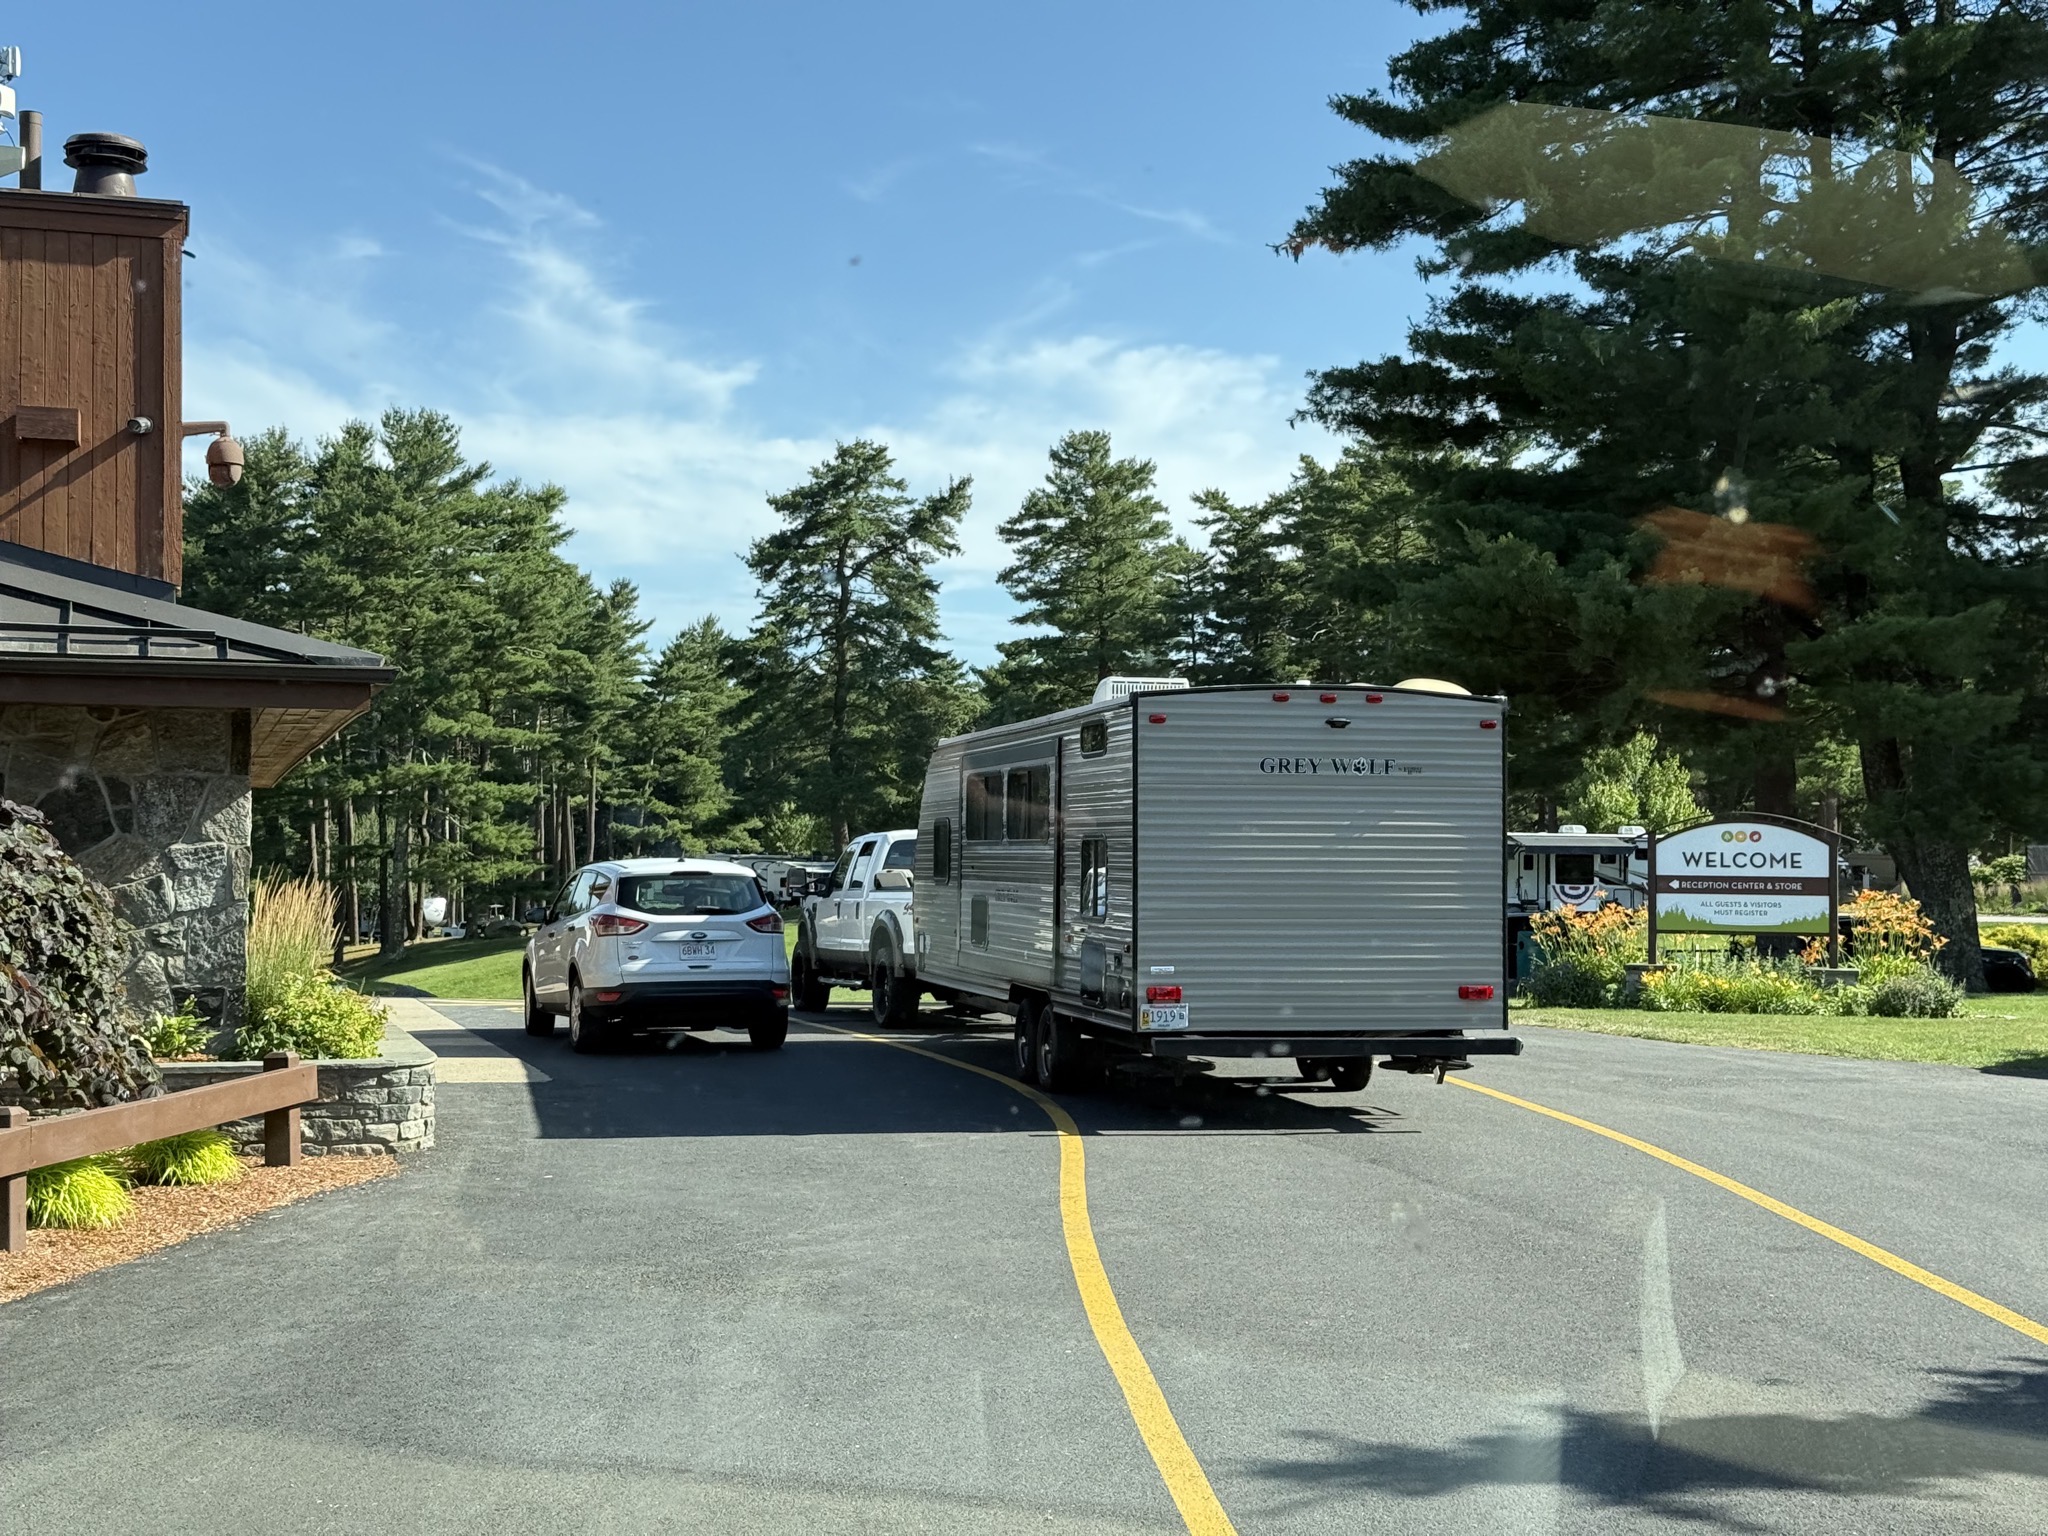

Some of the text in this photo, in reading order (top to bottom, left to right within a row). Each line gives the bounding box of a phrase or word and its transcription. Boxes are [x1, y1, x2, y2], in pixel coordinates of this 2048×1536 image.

[1259, 757, 1323, 774] GREY
[1682, 851, 1803, 869] WELCOME
[1681, 881, 1803, 891] RECEPTION CENTER & STORE
[1150, 1010, 1176, 1023] 1919
